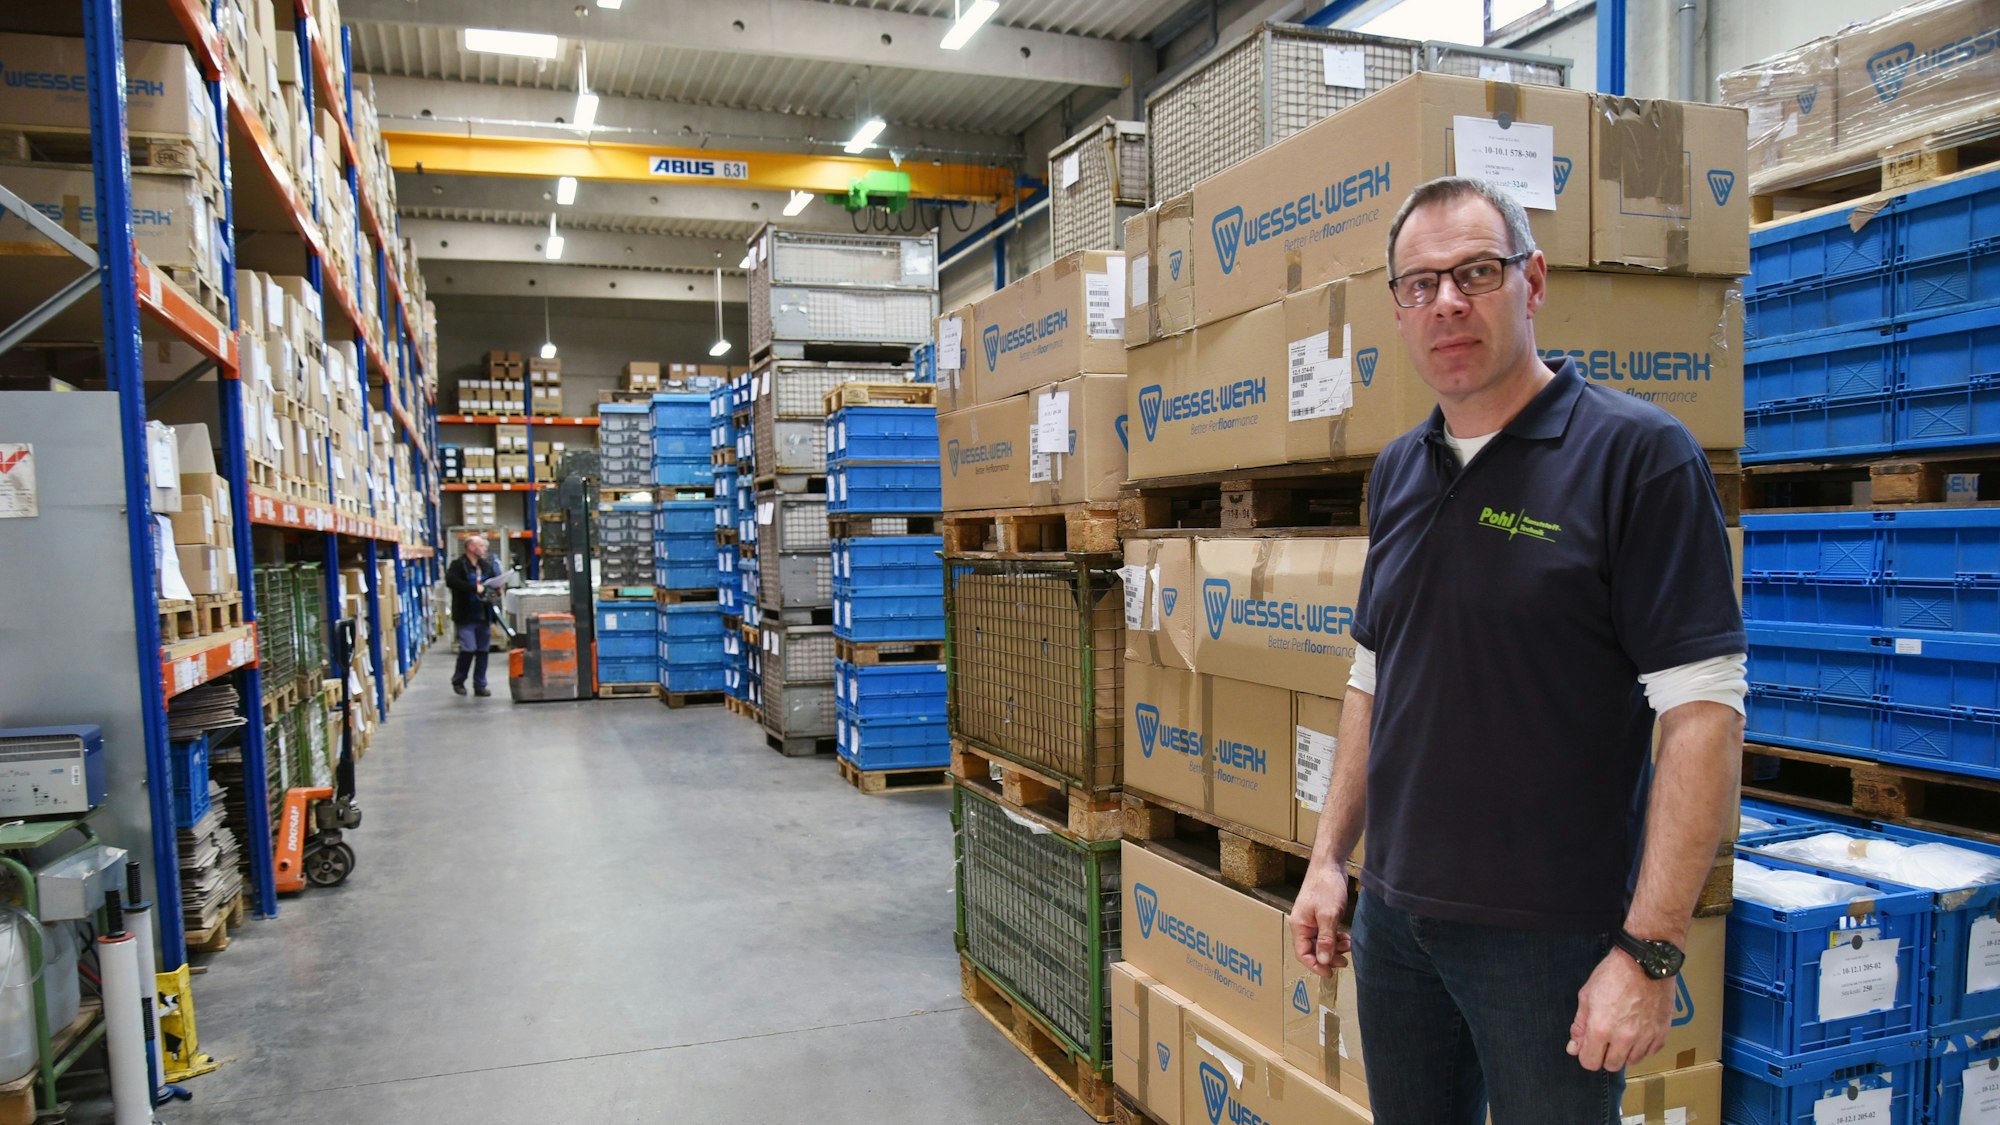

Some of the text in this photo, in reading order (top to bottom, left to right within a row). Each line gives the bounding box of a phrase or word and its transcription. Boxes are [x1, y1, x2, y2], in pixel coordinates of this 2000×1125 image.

[1510, 149, 1537, 159] 578-300
[653, 158, 715, 176] ABUS
[1512, 180, 1528, 189] 3240
[1284, 207, 1380, 252] Better Perfloormance
[1479, 507, 1516, 527] Pohl
[1230, 598, 1355, 635] WESSEL·WER
[1267, 635, 1290, 650] Better
